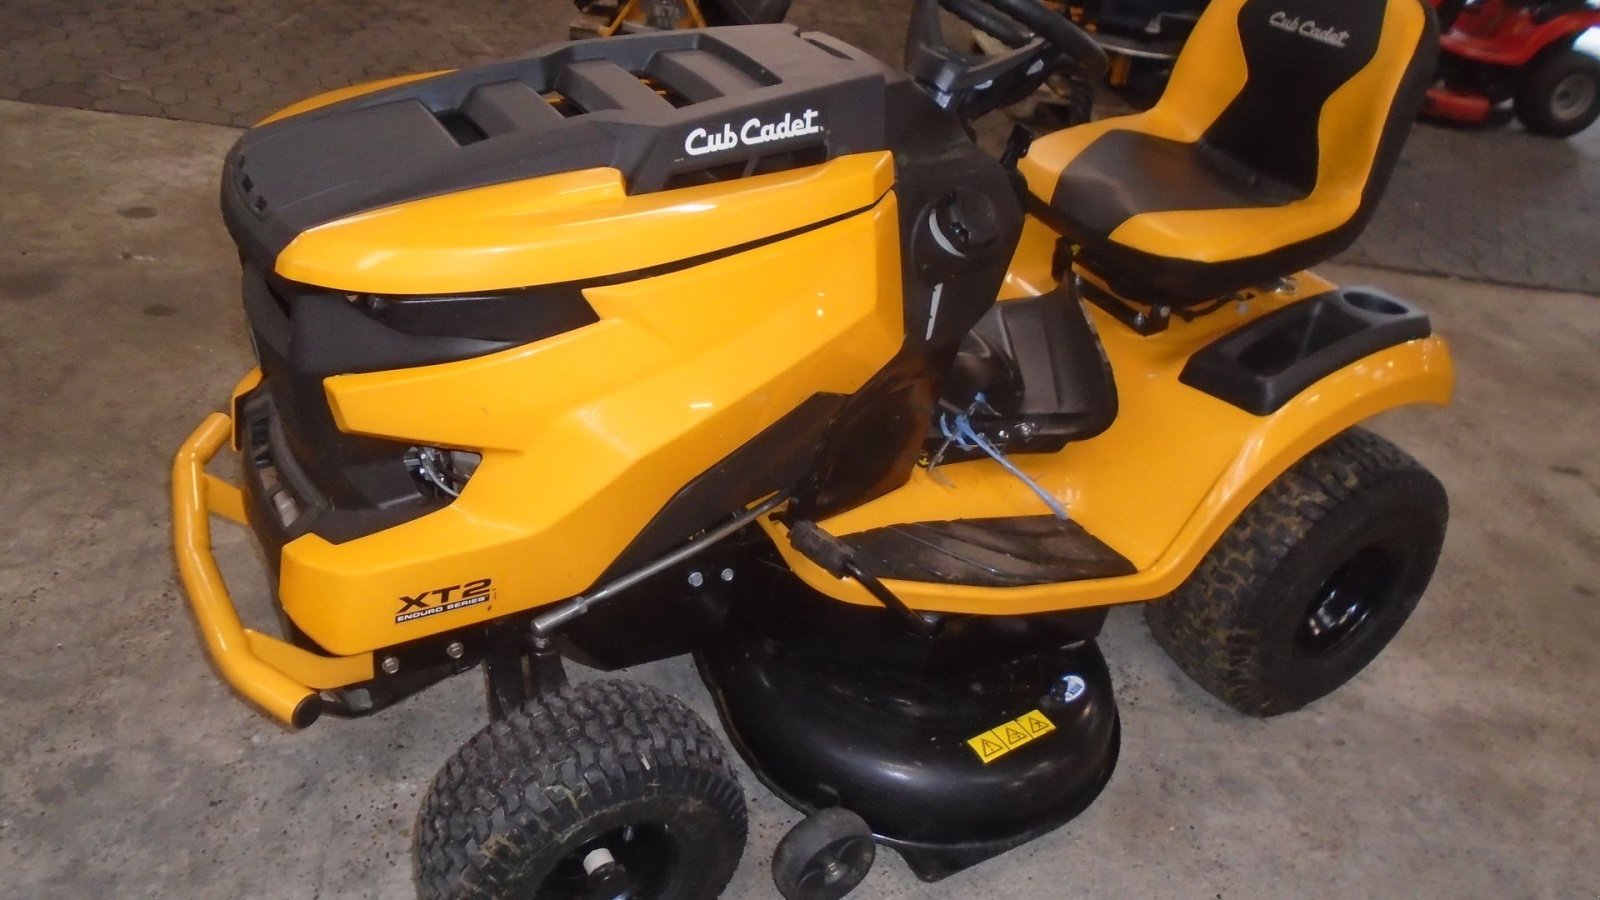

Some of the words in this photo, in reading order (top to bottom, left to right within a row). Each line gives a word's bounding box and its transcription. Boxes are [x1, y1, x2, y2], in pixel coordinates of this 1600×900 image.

[685, 123, 738, 155] Cub
[740, 109, 819, 145] Cadet
[396, 578, 491, 614] XT2
[397, 606, 444, 622] ENDURO
[446, 596, 486, 610] SERIES
